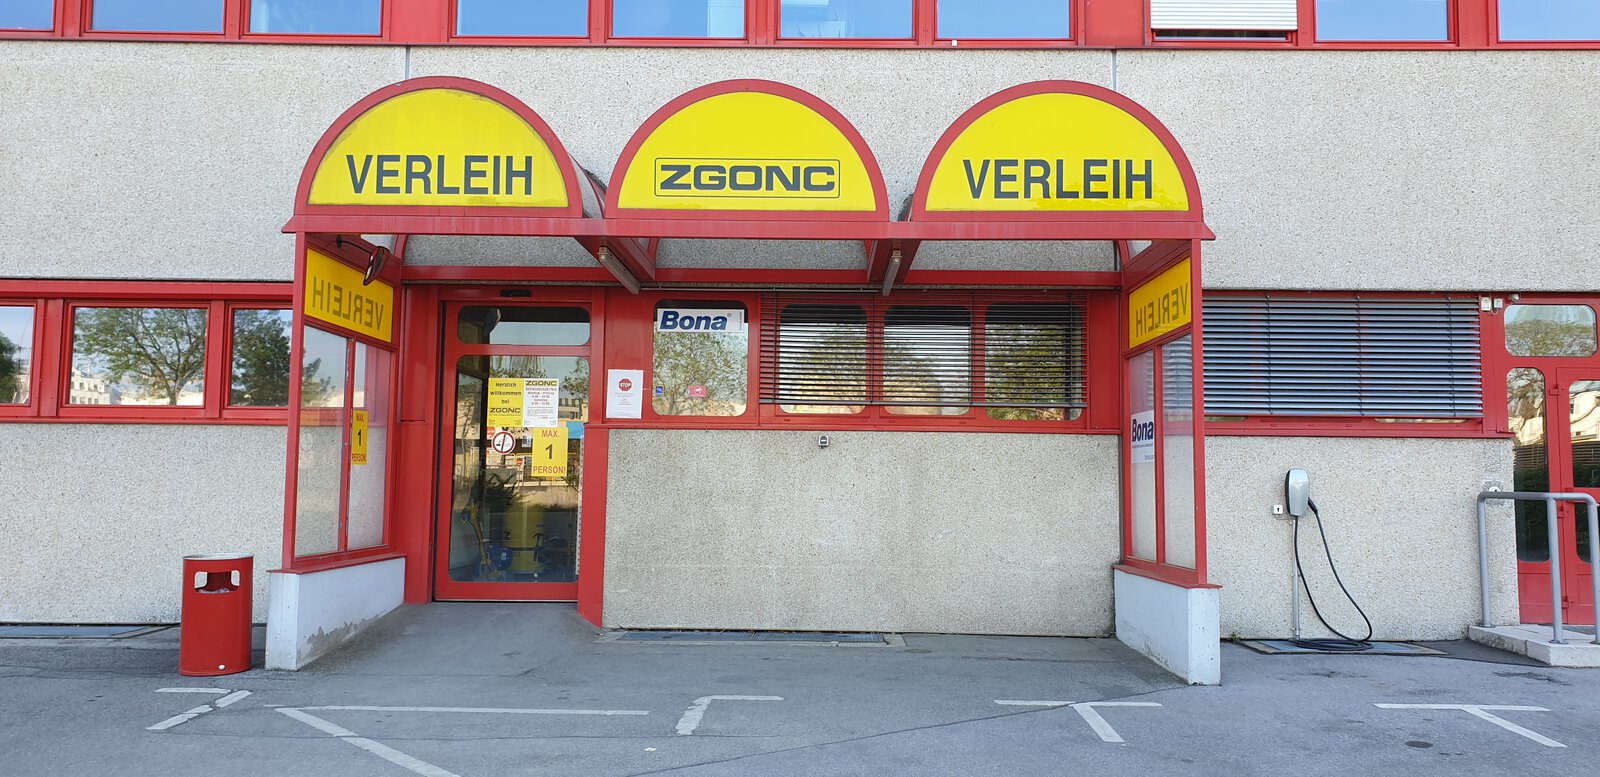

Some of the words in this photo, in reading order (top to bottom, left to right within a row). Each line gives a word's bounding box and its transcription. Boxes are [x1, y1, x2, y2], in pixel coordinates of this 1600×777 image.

[346, 154, 533, 196] VERLEIH
[660, 164, 835, 192] ZGONC
[962, 159, 1153, 199] VERLEIH
[358, 429, 362, 446] 1
[541, 429, 560, 438] MAX.
[1132, 418, 1153, 442] Bona
[545, 444, 553, 460] 1
[532, 465, 566, 474] PERSON!
